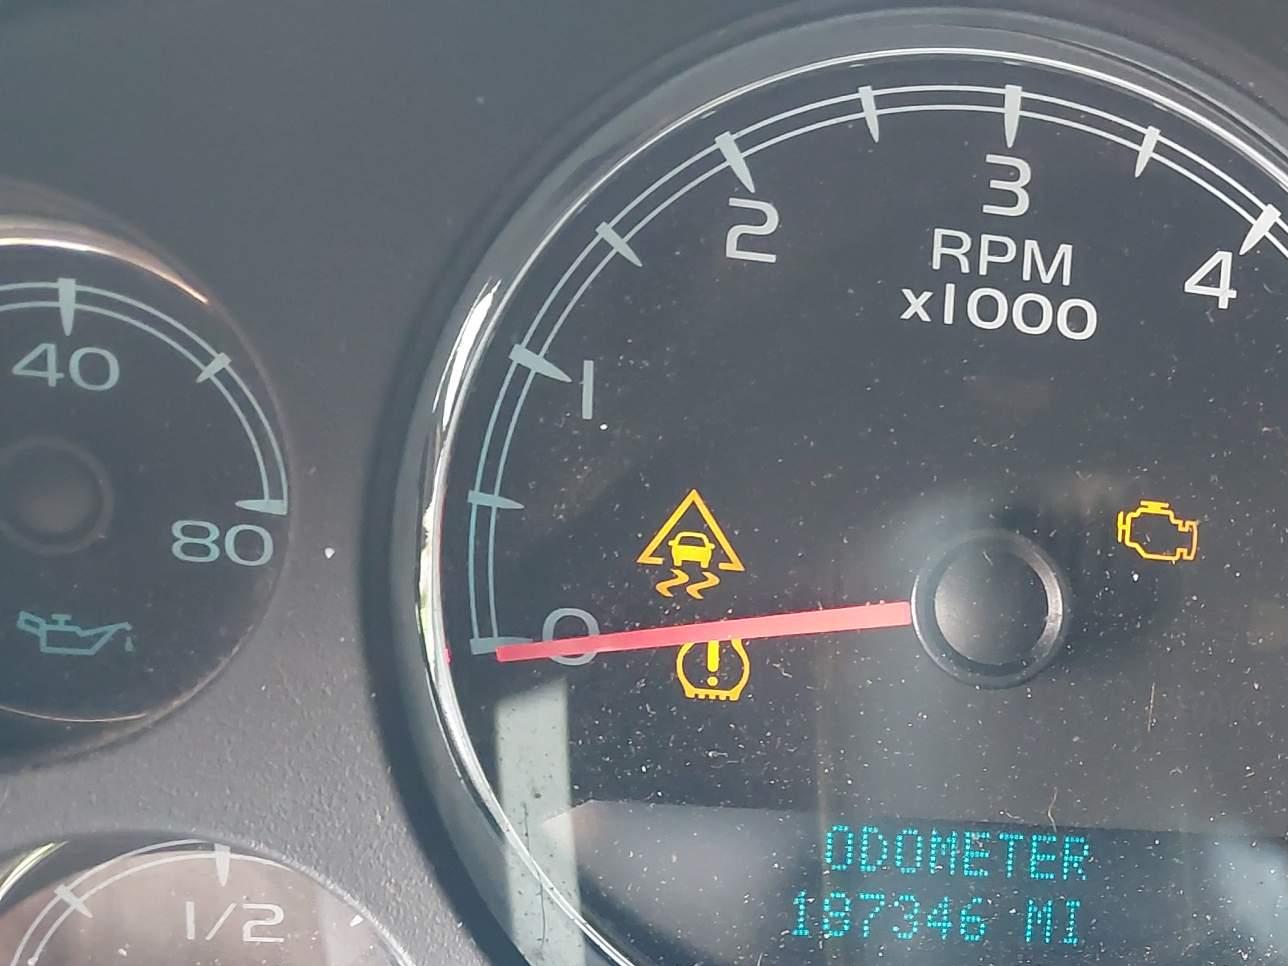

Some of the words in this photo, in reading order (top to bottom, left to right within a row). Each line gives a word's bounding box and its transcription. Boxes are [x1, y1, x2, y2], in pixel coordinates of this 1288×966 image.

[981, 151, 1033, 217] 3
[725, 197, 781, 262] 2
[931, 227, 1074, 286] RPM
[1183, 249, 1237, 309] 4
[11, 341, 121, 391] 40
[169, 519, 275, 567] 80
[542, 607, 599, 666] 0
[825, 823, 1091, 881] ODOMETER
[183, 899, 285, 943] 1/2
[790, 889, 987, 942] 187346
[1024, 897, 1081, 945] MI
